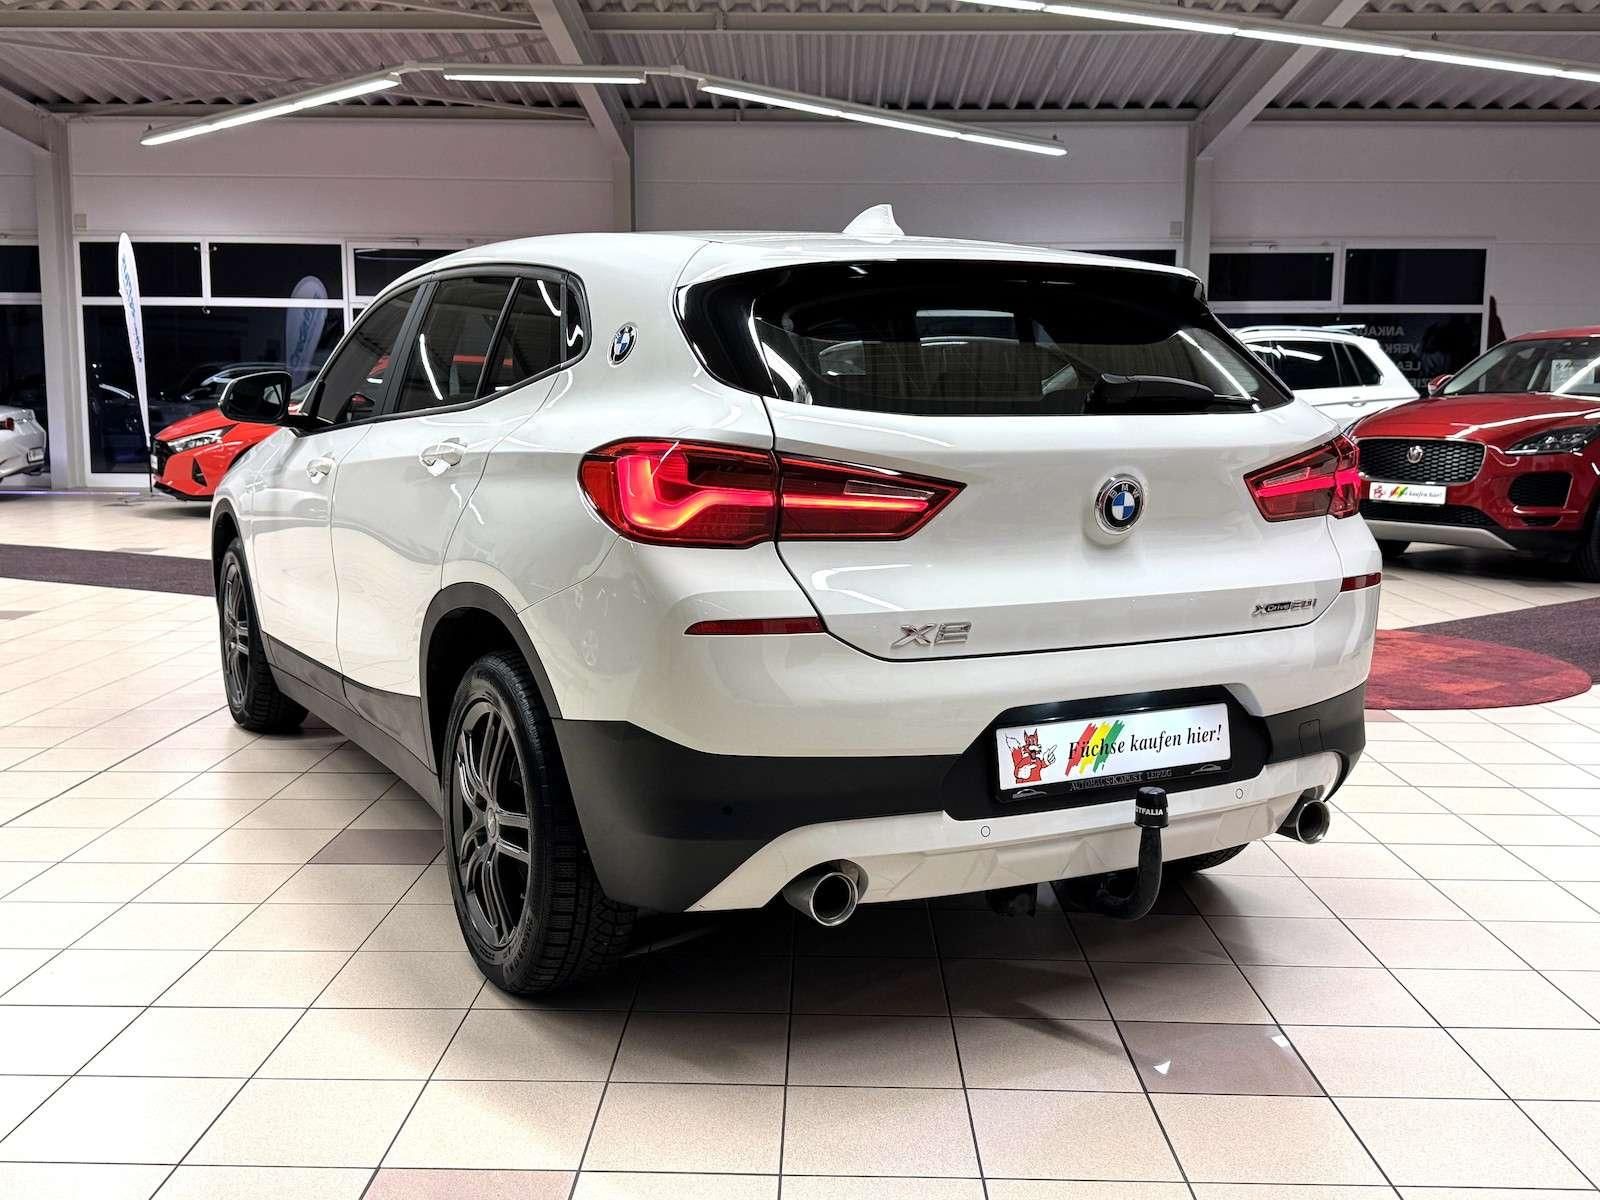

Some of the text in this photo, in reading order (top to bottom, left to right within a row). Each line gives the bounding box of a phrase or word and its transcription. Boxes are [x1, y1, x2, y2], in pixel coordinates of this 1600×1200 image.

[1069, 724, 1222, 760] Füchse kaufen hier!
